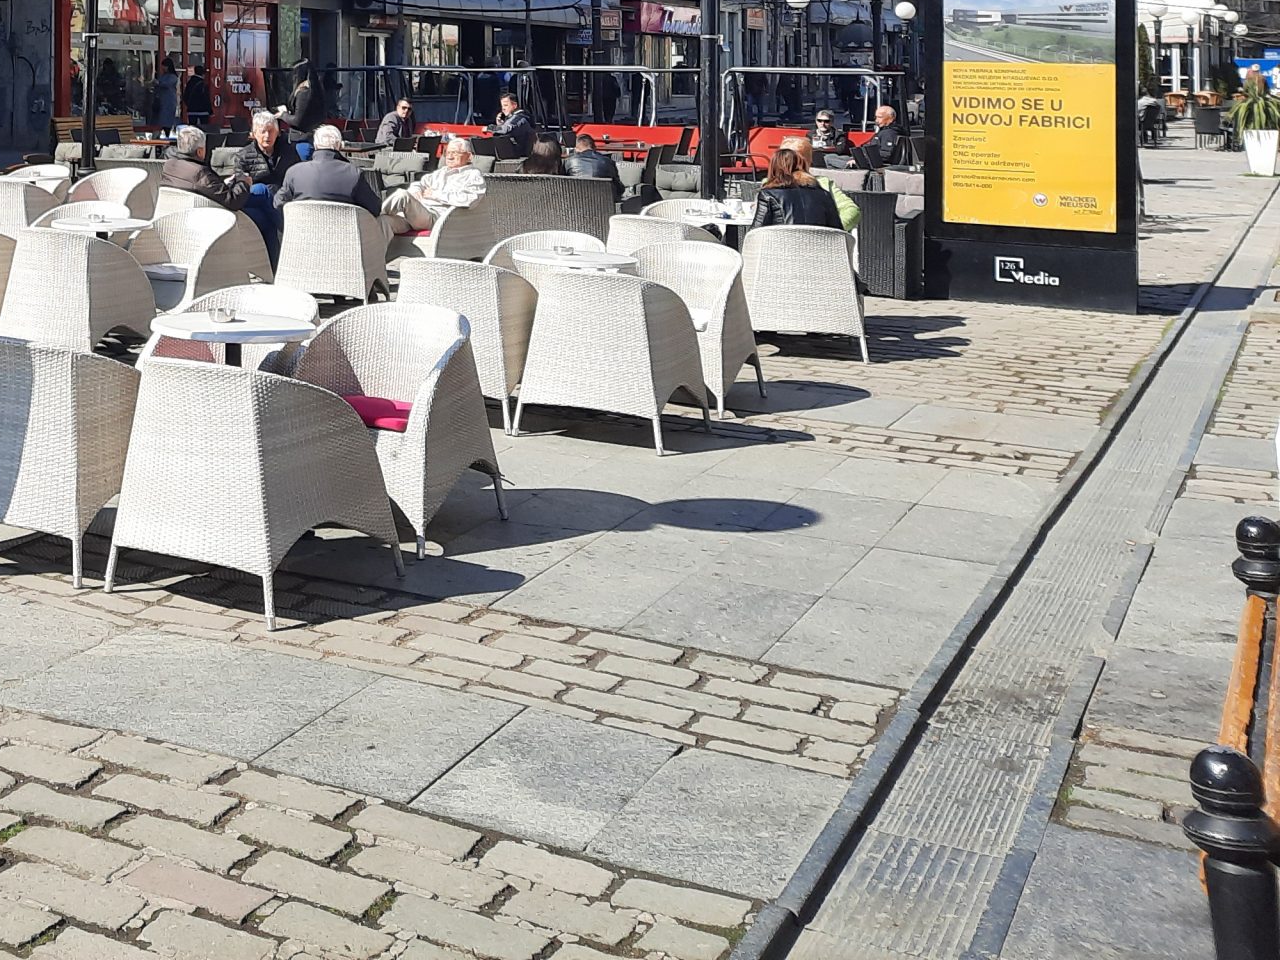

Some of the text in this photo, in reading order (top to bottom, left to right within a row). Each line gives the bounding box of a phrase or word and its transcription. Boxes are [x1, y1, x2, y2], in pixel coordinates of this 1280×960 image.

[952, 96, 1063, 112] VIDIMO SE U
[952, 112, 1091, 129] NOVOJ FABRICI
[1059, 195, 1097, 203] WACKER
[1060, 201, 1097, 209] NEUSON
[1000, 262, 1016, 270] 126
[1011, 271, 1060, 286] Media
